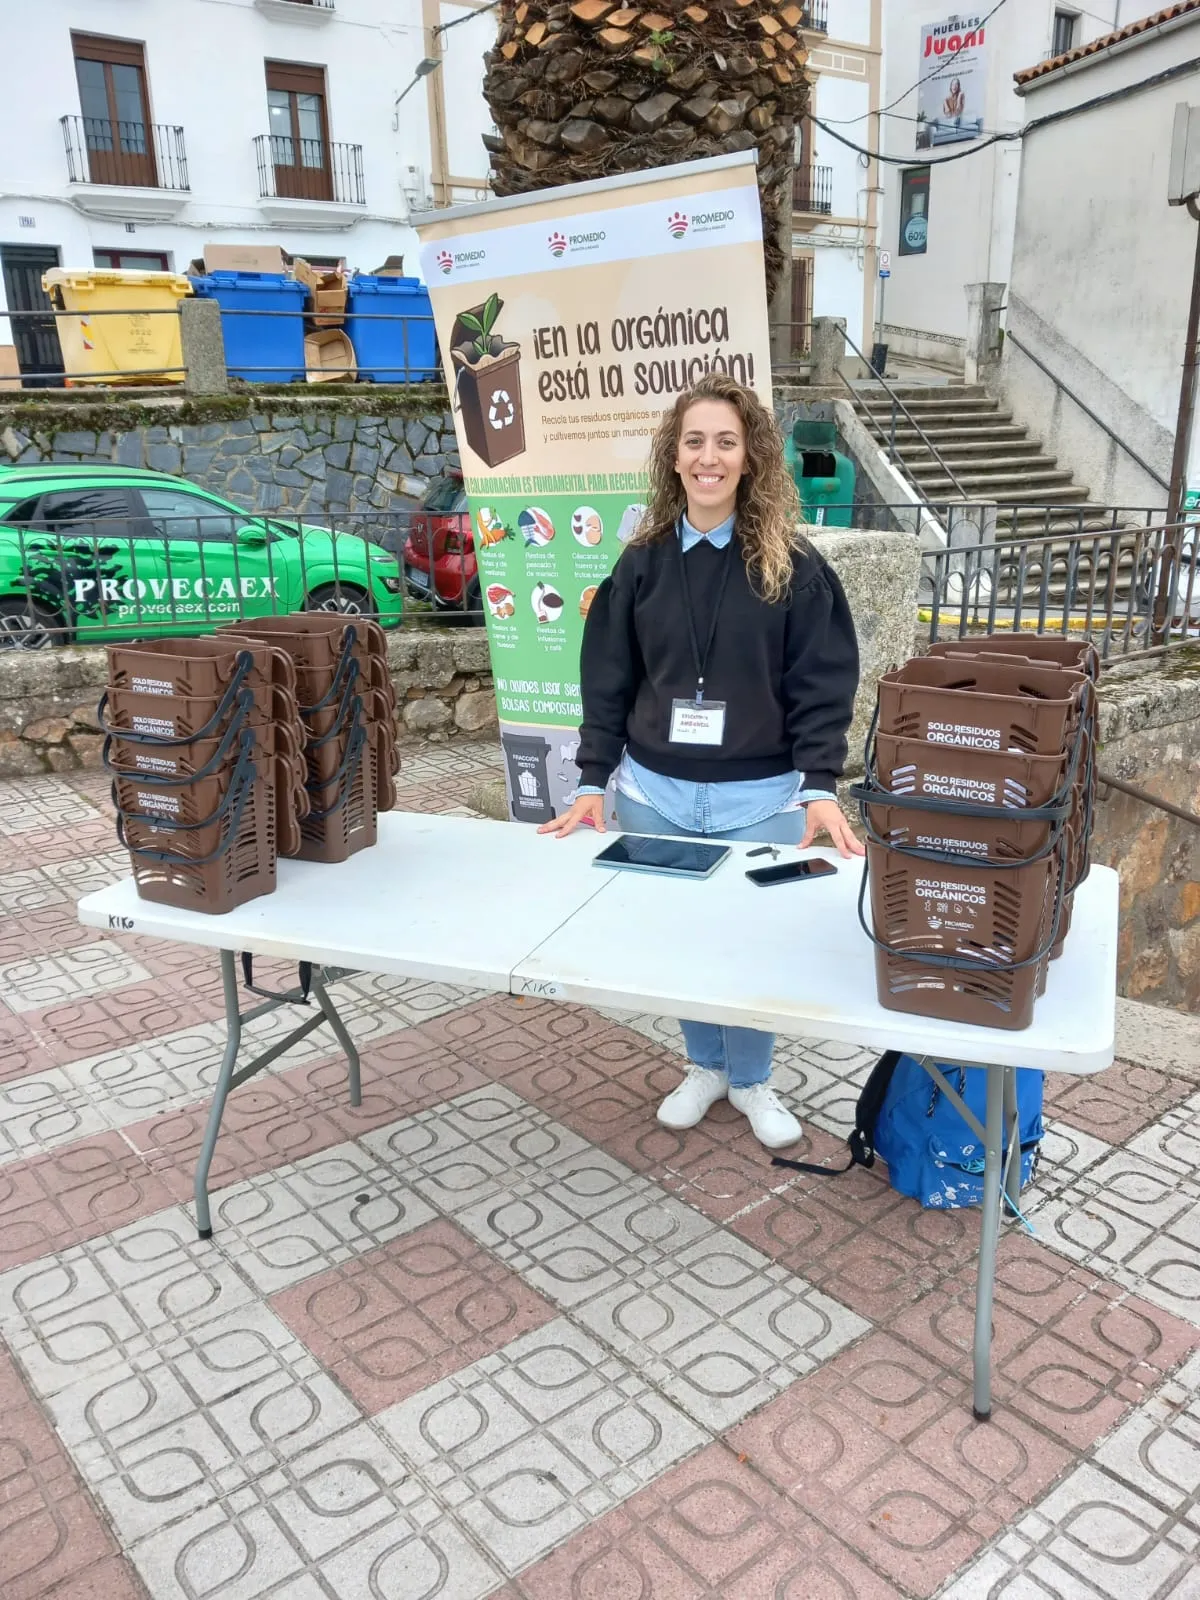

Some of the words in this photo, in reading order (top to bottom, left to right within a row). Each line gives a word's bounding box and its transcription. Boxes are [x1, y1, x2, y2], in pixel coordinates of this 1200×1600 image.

[934, 17, 980, 36] MUEBLES
[924, 28, 985, 57] Juani
[691, 210, 735, 225] PROMEDIO
[569, 231, 607, 245] PROMEDIO
[454, 250, 486, 263] PROMEDIO
[577, 321, 601, 356] la
[538, 361, 590, 403] está
[599, 364, 625, 398] la
[541, 415, 568, 425] Recicla
[568, 415, 580, 424] tus
[581, 412, 612, 423] residuos
[613, 409, 650, 423] orgánicos
[651, 410, 661, 418] en
[543, 435, 548, 443] y
[549, 430, 586, 441] cultivemos
[587, 429, 610, 441] juntos
[611, 430, 621, 438] un
[622, 426, 649, 437] mundo
[470, 474, 522, 494] COLABORACIÓN
[523, 476, 533, 492] ES
[533, 474, 587, 493] FUNDAMENTAL
[588, 474, 609, 491] PARA
[73, 577, 280, 602] PROVECAEX
[118, 602, 241, 618] provecaex.com
[501, 697, 530, 713] BOLSAS
[532, 700, 582, 717] COMPOSTAB
[132, 716, 147, 724] SOLO
[148, 718, 174, 728] RESIDUOS
[927, 721, 953, 732] SOLO
[954, 724, 1001, 738] RESIDUOS
[926, 731, 1001, 750] ORGÁNICOS
[135, 754, 150, 762] SOLO
[150, 758, 177, 768] RESIDUOS
[923, 773, 949, 784] SOLO
[949, 776, 997, 792] RESIDUOS
[137, 791, 152, 799] SOLO
[152, 794, 178, 804] RESIDUOS
[922, 783, 996, 803] ORGÁNICOS
[138, 799, 179, 813] ORGÁNICOS
[916, 835, 942, 846] SOLO
[942, 838, 989, 851] RESIDUOS
[915, 878, 940, 888] SOLO
[940, 881, 986, 894] RESIDUOS
[915, 887, 987, 905] ORGÁNICOS
